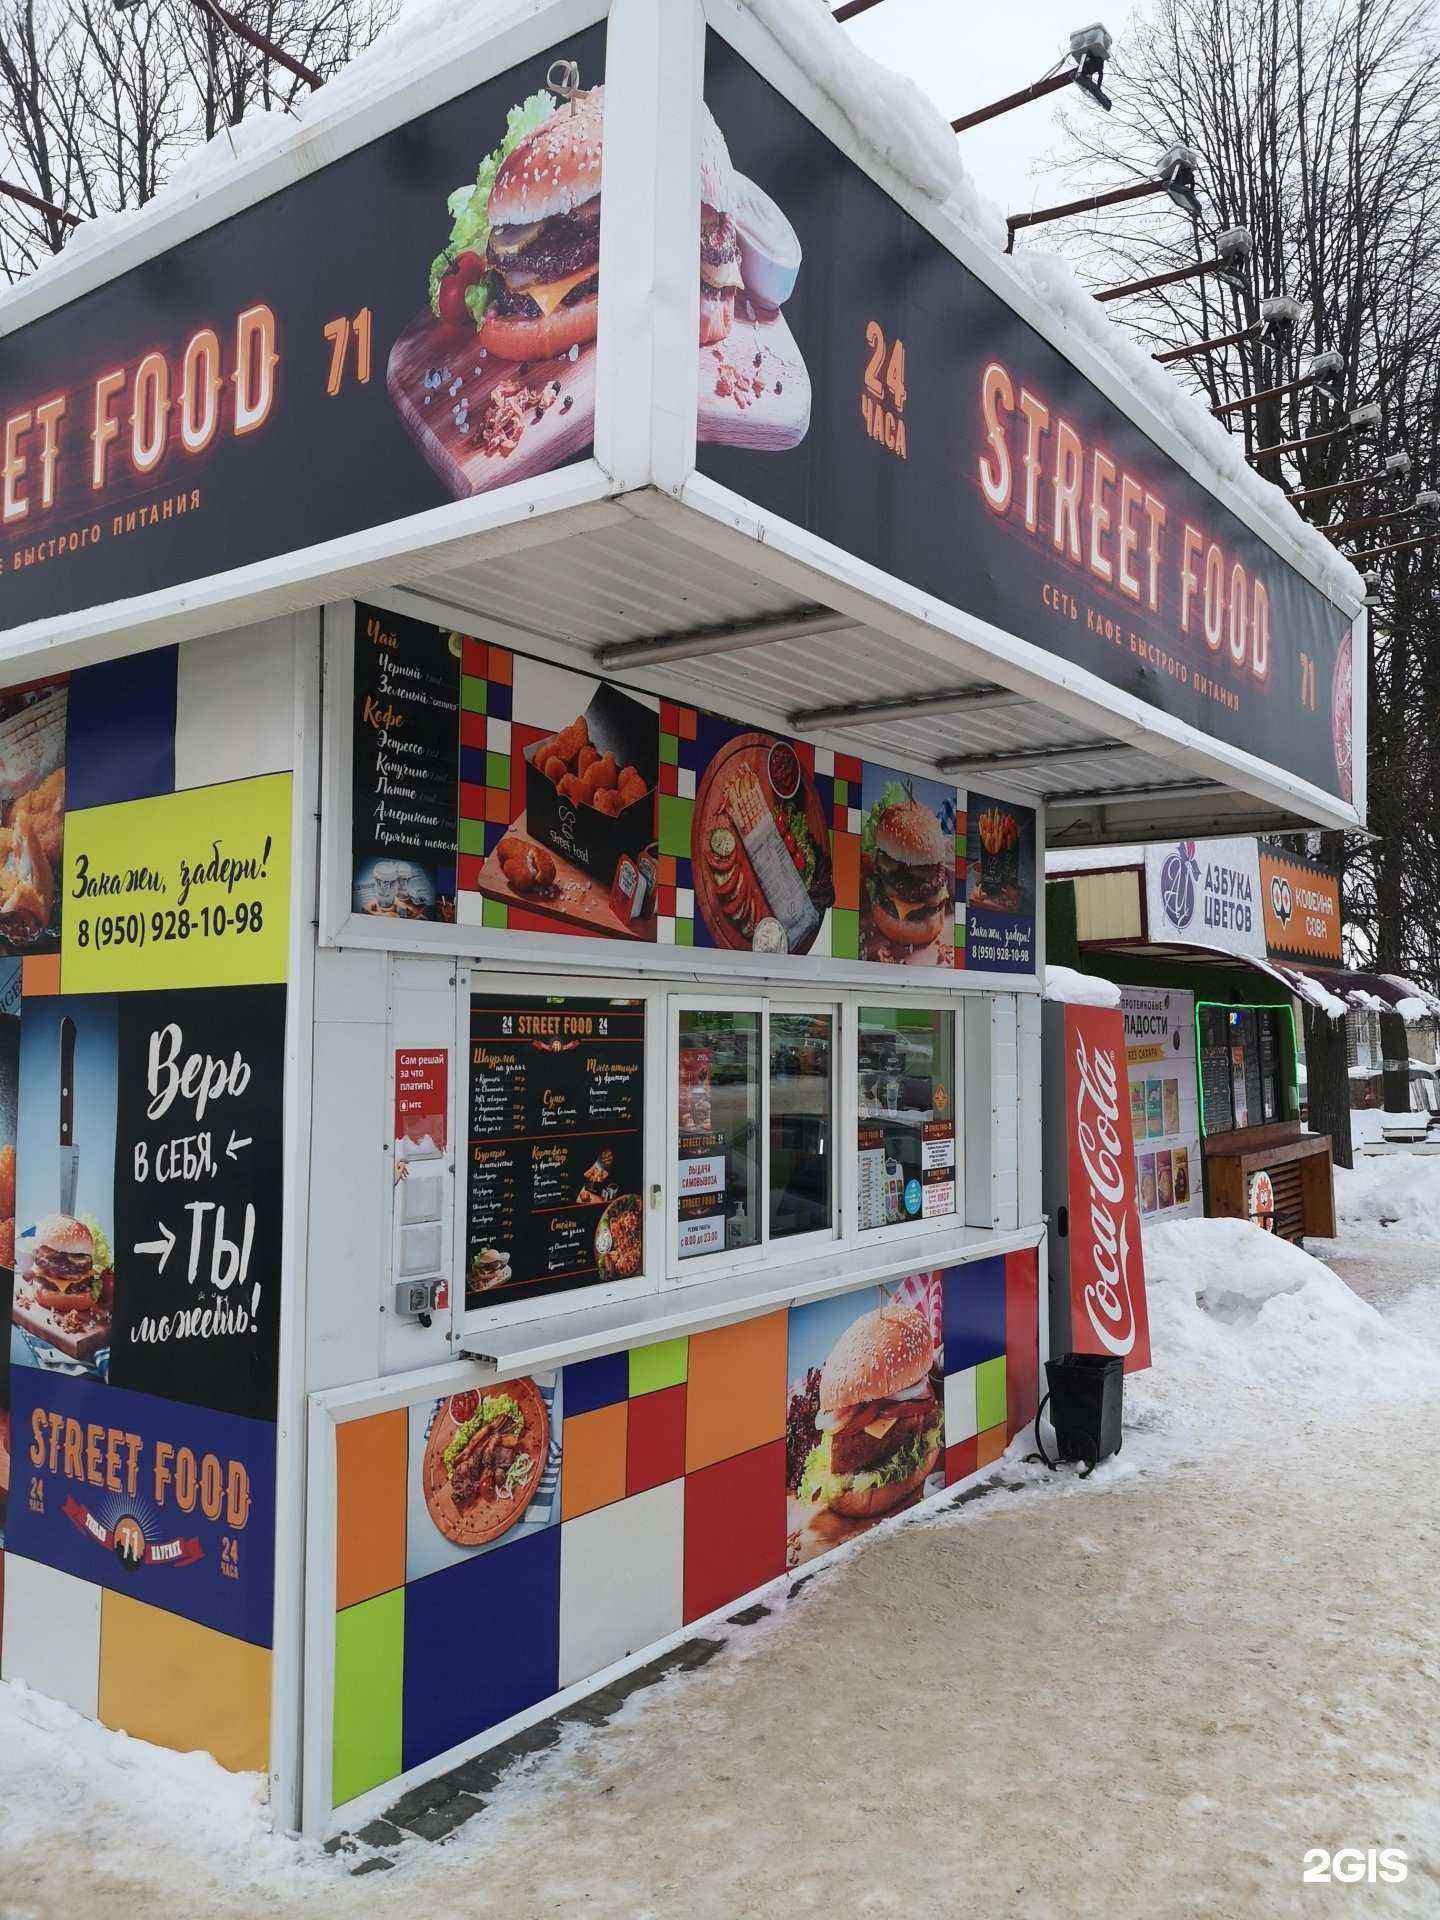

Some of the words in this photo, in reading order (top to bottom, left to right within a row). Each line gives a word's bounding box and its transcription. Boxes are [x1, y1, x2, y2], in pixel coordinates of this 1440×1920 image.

[323, 306, 373, 396] 71
[864, 320, 907, 411] 24
[90, 303, 280, 490] FOOD
[861, 394, 907, 460] ЧАСА
[13, 524, 101, 570] БЫСТРОГО
[113, 488, 201, 536] ПИТАНИЯ
[978, 361, 1168, 613] STREET
[1180, 524, 1271, 680] FOOD
[366, 617, 399, 648] Чай
[1042, 583, 1079, 618] СЕТЬ
[1087, 607, 1122, 645] КАФЕ
[1130, 624, 1188, 684] БЫСТРОГО
[1194, 667, 1240, 713] ПИТАНИЯ
[378, 653, 422, 681] Черный
[378, 674, 428, 704] Зеленый
[362, 695, 405, 730] Кофе
[378, 730, 425, 757] Эспрессо
[375, 753, 428, 780] Капучино
[375, 777, 417, 800] Латте
[373, 799, 439, 827] Американо
[374, 823, 421, 848] Горячий
[72, 854, 167, 899] Закажи,
[177, 835, 272, 906] забери!
[1204, 863, 1253, 902] АЗБУКА
[1204, 896, 1252, 932] ЦВЕТОВ
[1295, 887, 1334, 916] КОФЕЙНЯ
[77, 919, 90, 948] 8
[95, 912, 146, 951] (950)
[151, 901, 264, 943] 928-10-98
[1306, 916, 1328, 940] СОВА
[971, 945, 977, 958] 8
[978, 945, 996, 962] (950)
[996, 947, 1030, 963] 928-10-98
[502, 1015, 513, 1028] 24
[518, 1016, 561, 1035] STREET
[563, 1016, 593, 1035] FOOD
[146, 1022, 251, 1122] Верь
[400, 1054, 417, 1065] Сам
[400, 1070, 409, 1078] за
[410, 1069, 424, 1078] что
[400, 1079, 434, 1091] платить!
[133, 1140, 149, 1183] В
[155, 1131, 218, 1184] СЕБЯ,
[1075, 1024, 1136, 1357] Coca-Cola
[184, 1200, 256, 1290] ТЫ
[130, 1281, 262, 1344] можешь!
[29, 1406, 144, 1499] STREET
[153, 1440, 252, 1530] FOOD
[221, 1536, 239, 1565] 24
